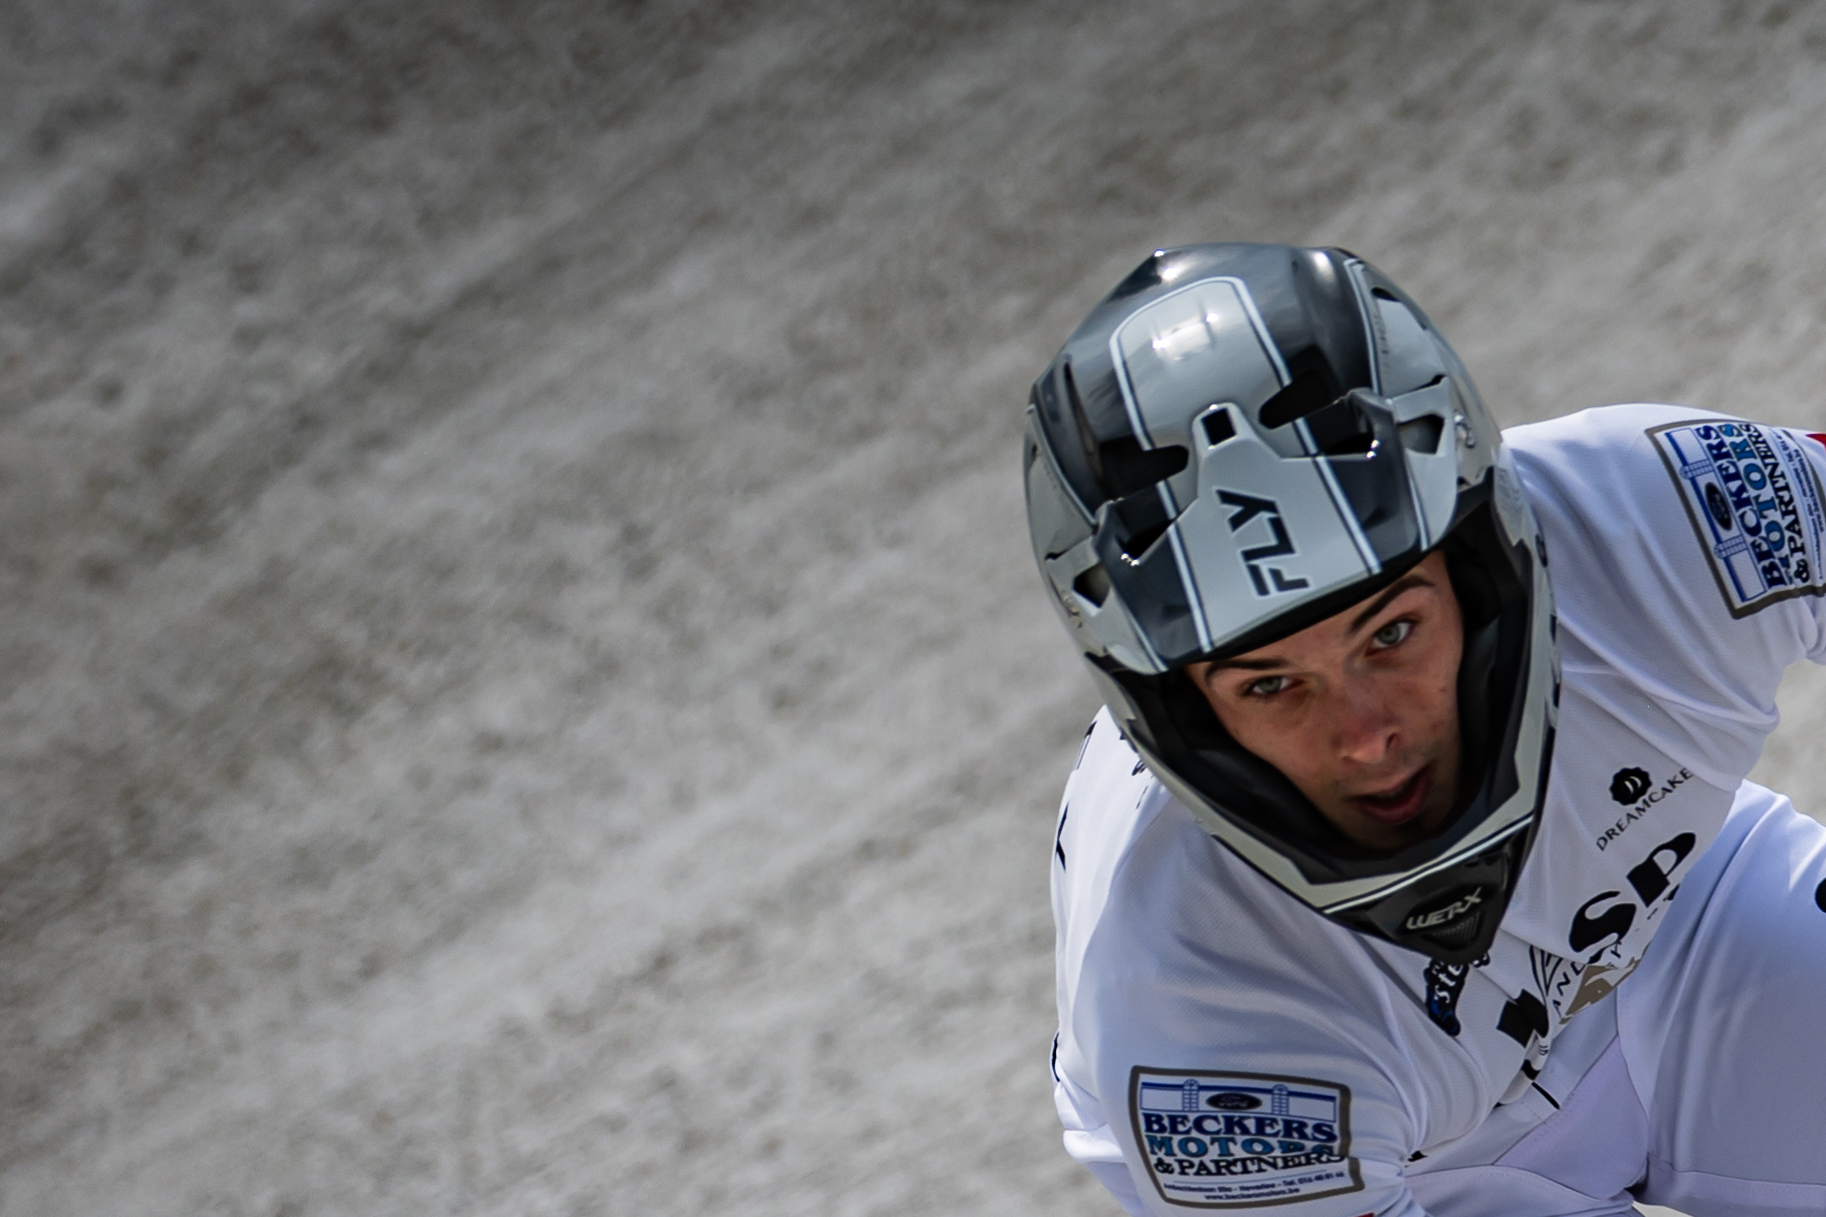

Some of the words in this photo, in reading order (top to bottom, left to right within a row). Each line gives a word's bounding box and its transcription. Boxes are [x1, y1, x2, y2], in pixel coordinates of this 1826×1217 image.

[1212, 489, 1311, 597] FLY
[1695, 425, 1788, 588] BECKERS
[1595, 767, 1694, 852] DREAMCAKE
[1405, 886, 1484, 930] WERX
[1142, 1112, 1338, 1143] BECKERS
